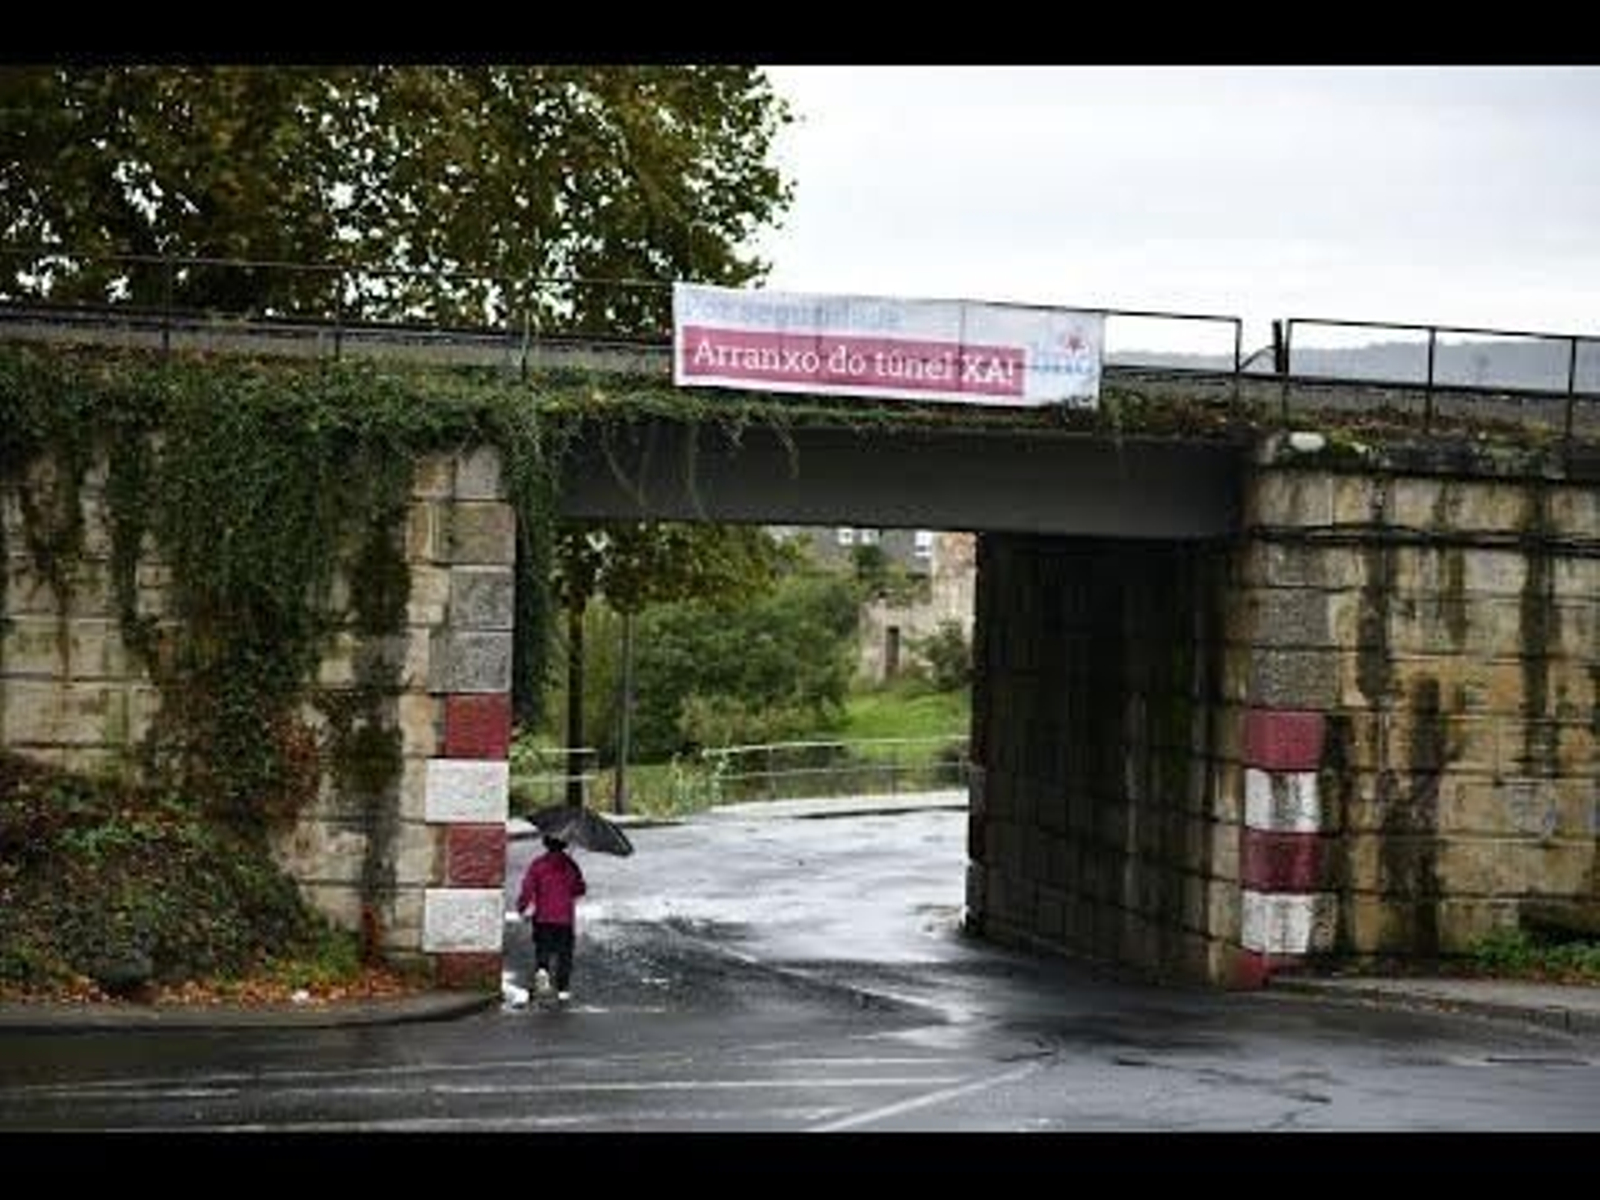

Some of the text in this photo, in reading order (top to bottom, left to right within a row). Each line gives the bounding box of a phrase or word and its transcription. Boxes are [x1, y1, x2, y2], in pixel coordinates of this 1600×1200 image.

[694, 337, 820, 374] Arranxo
[828, 345, 866, 376] do
[961, 354, 1014, 387] XA!
